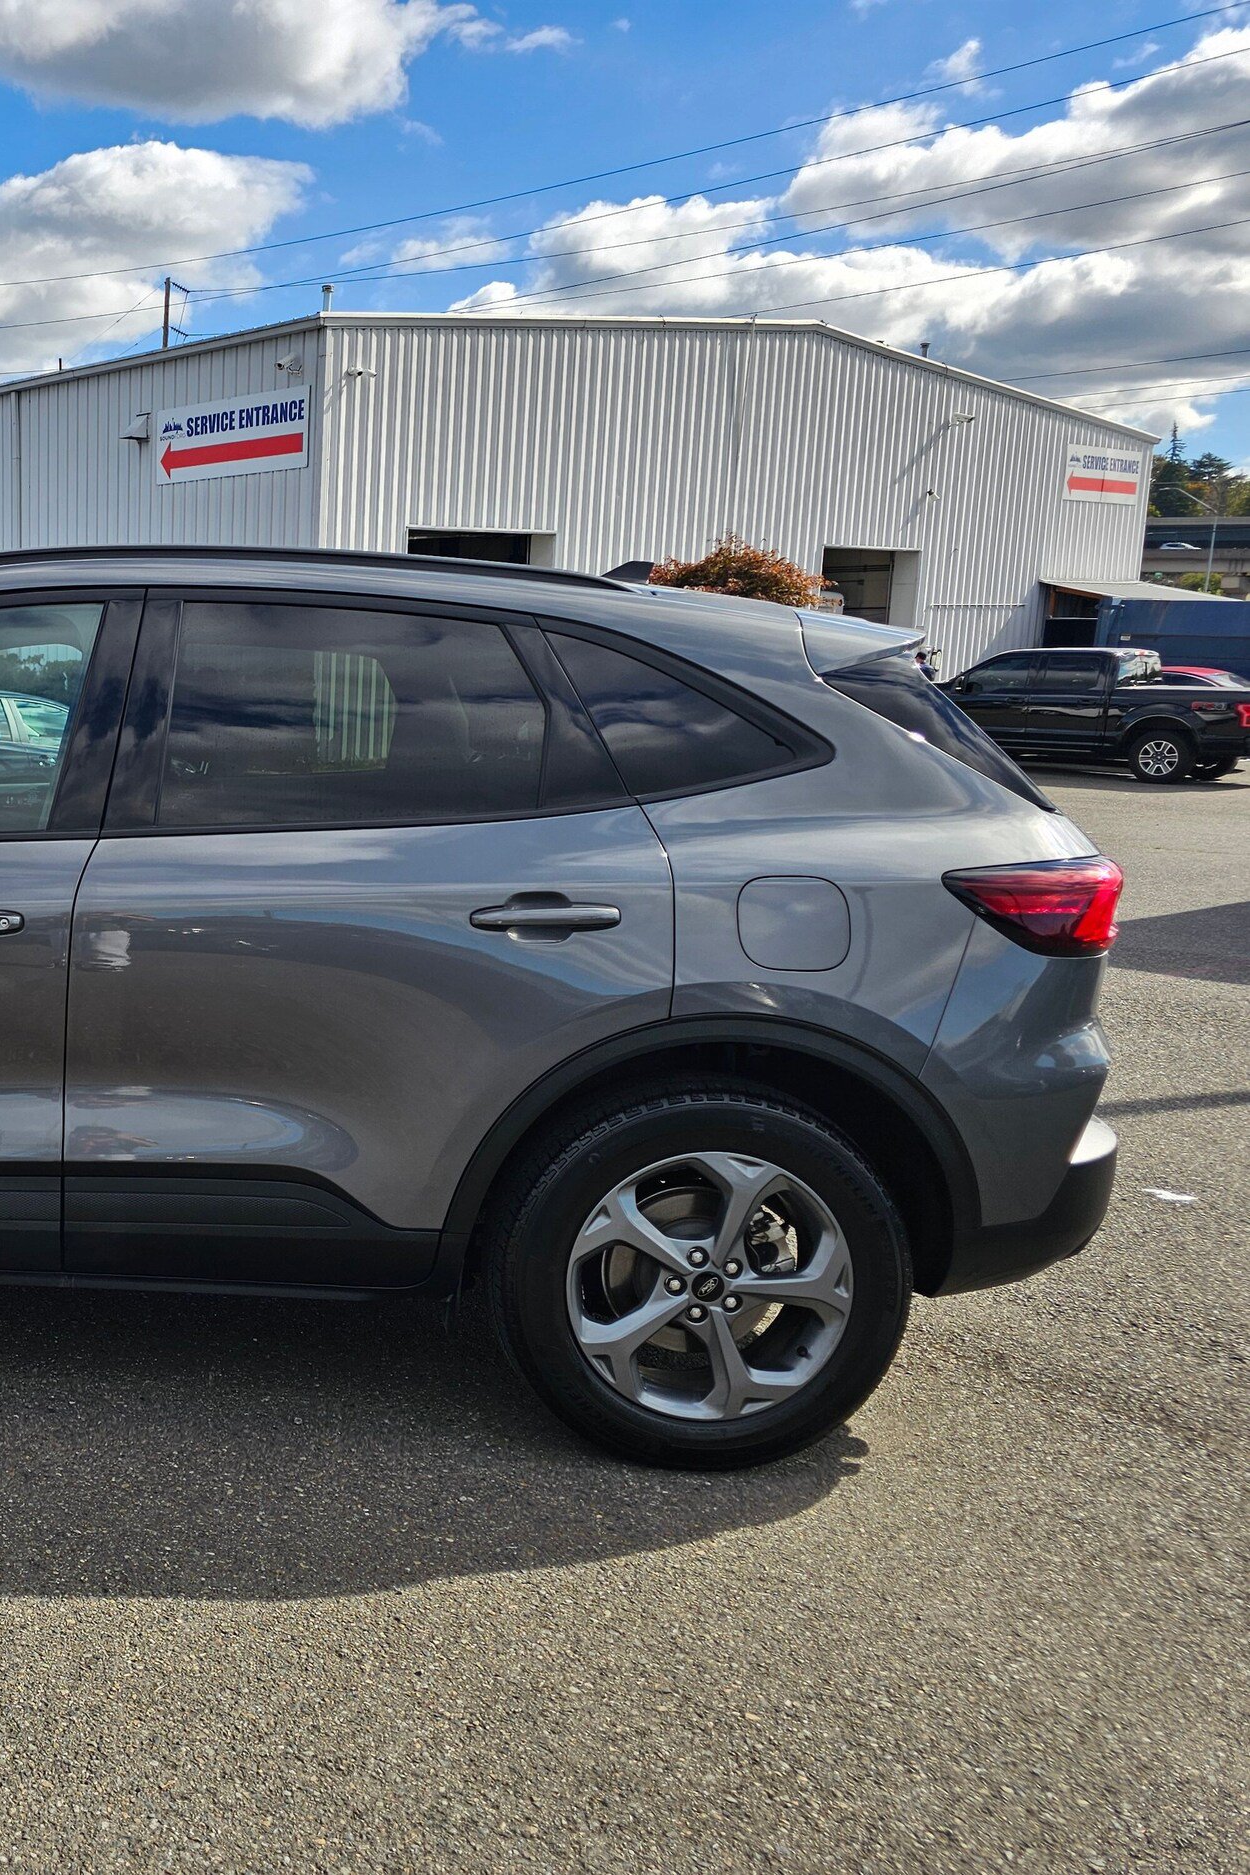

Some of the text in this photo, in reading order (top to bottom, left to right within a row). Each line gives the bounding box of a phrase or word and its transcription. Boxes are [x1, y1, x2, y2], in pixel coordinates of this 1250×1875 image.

[186, 399, 305, 437] SERVICE ENTRANCE
[1082, 455, 1140, 474] SERVICE ENTRANCE
